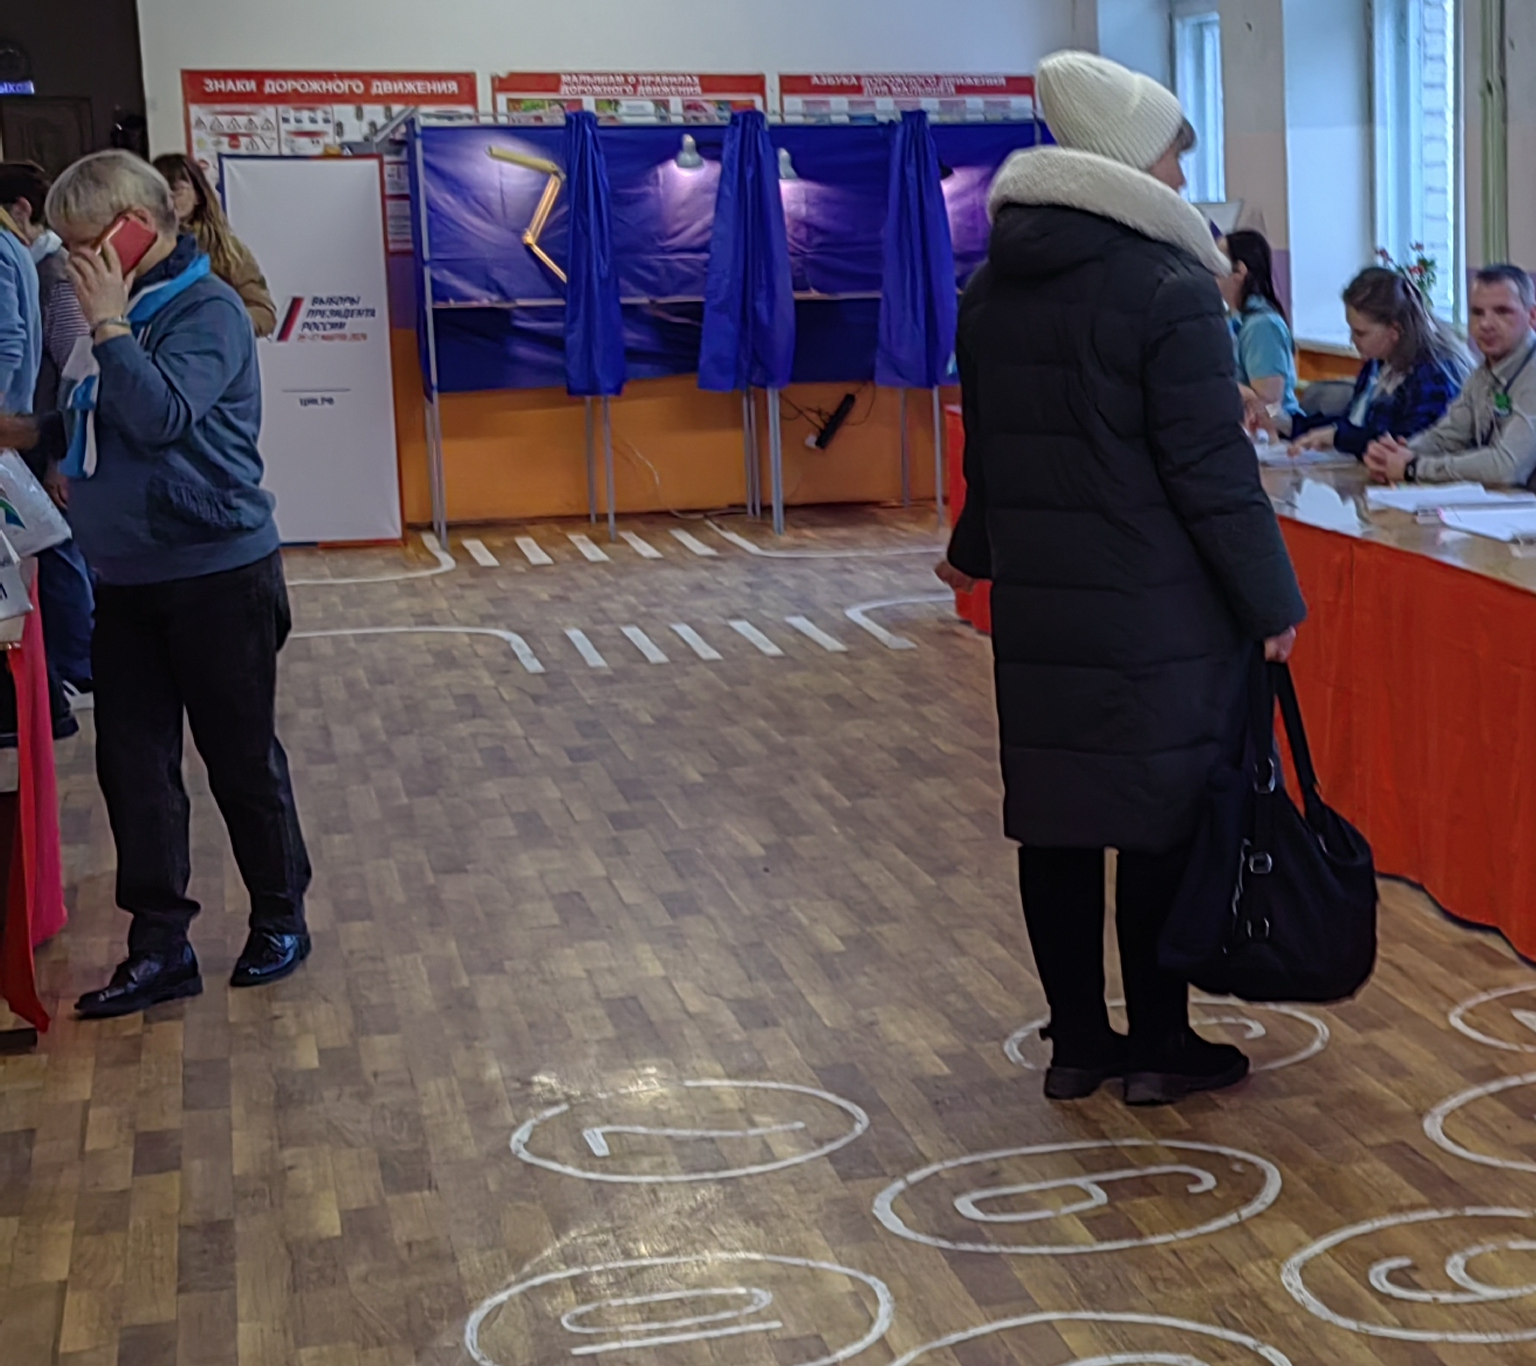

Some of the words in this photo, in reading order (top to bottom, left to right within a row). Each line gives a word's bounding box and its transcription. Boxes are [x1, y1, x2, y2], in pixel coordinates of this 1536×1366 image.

[203, 78, 257, 93] ЗНАКИ
[264, 78, 365, 95] ДОРОЖНОГО
[371, 79, 459, 95] ДВИЖЕНИЯ
[311, 296, 361, 307] ВЫБОРЫ
[306, 308, 376, 320] ПРЕЗИДЕНТА
[301, 321, 346, 332] РОССИИ
